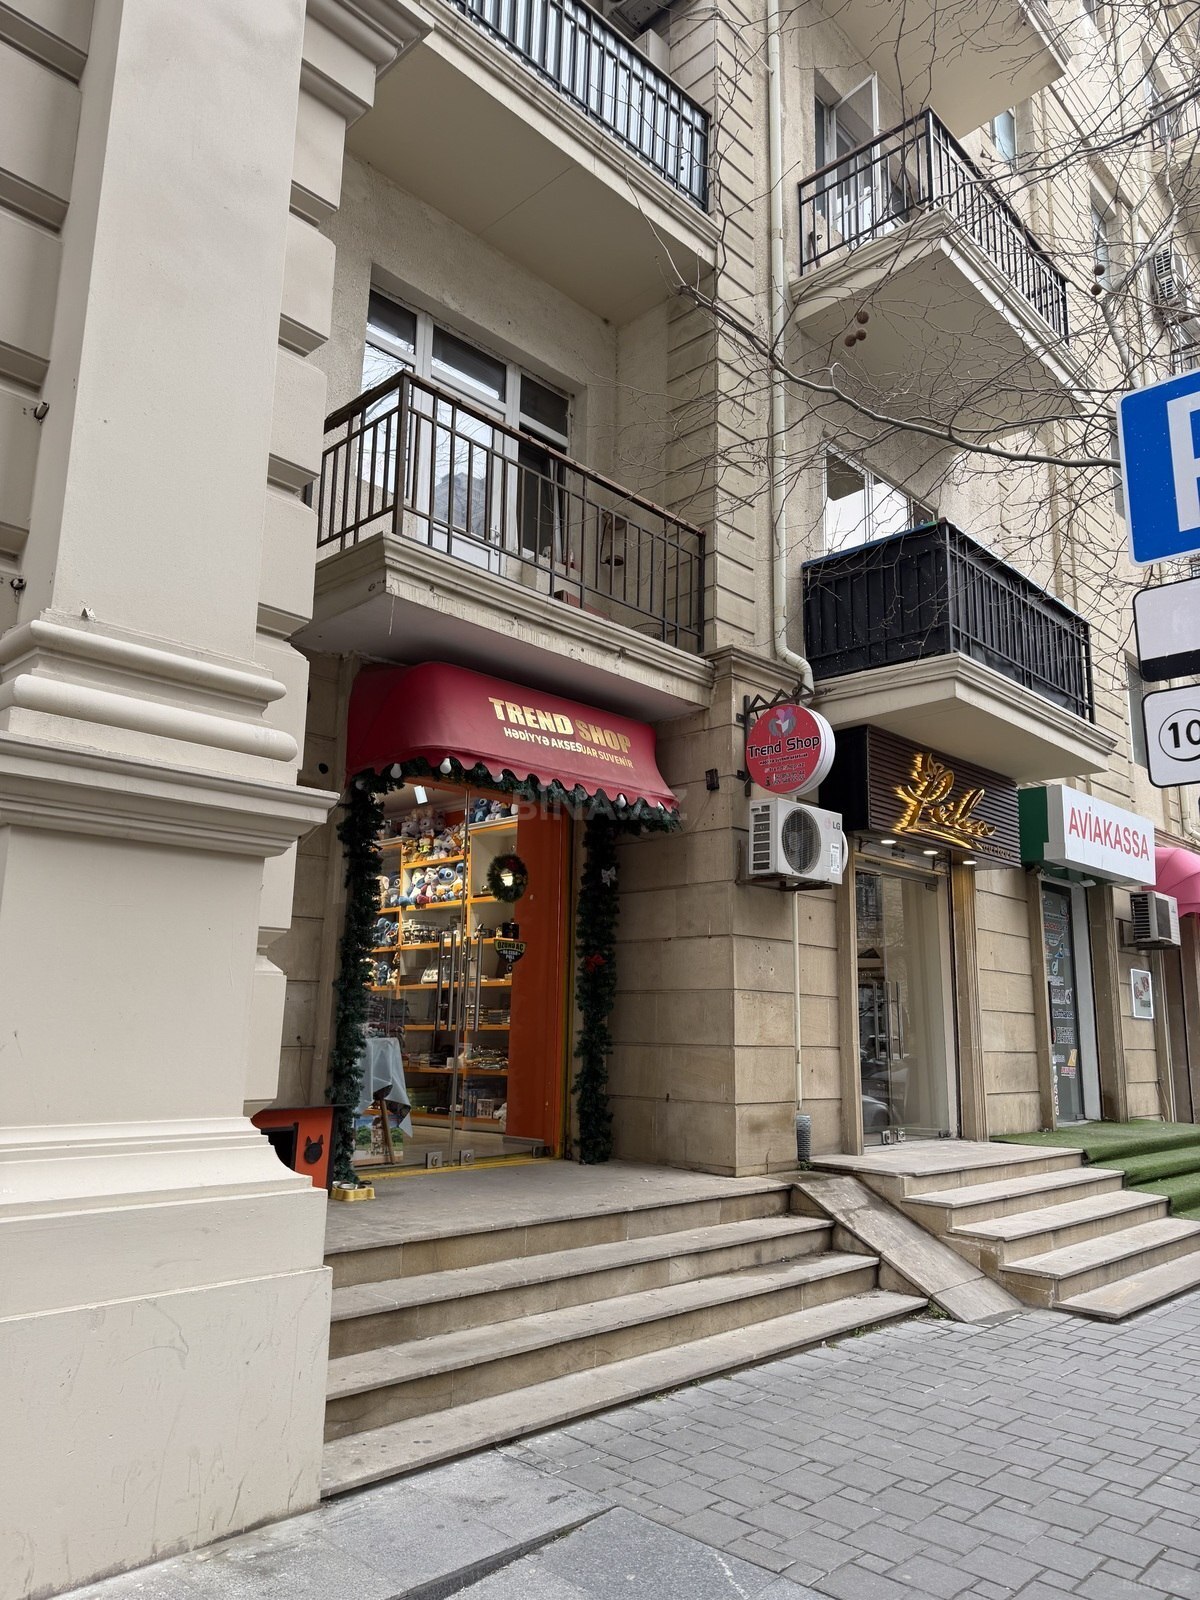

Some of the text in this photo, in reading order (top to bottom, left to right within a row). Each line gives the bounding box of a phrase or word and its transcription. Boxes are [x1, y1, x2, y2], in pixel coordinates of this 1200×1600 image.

[488, 697, 632, 753] TREND SHOP
[551, 738, 599, 758] AKSESUAR
[747, 736, 820, 758] Trend Shop
[832, 821, 841, 831] LG
[1069, 806, 1149, 861] AVİAKASSA
